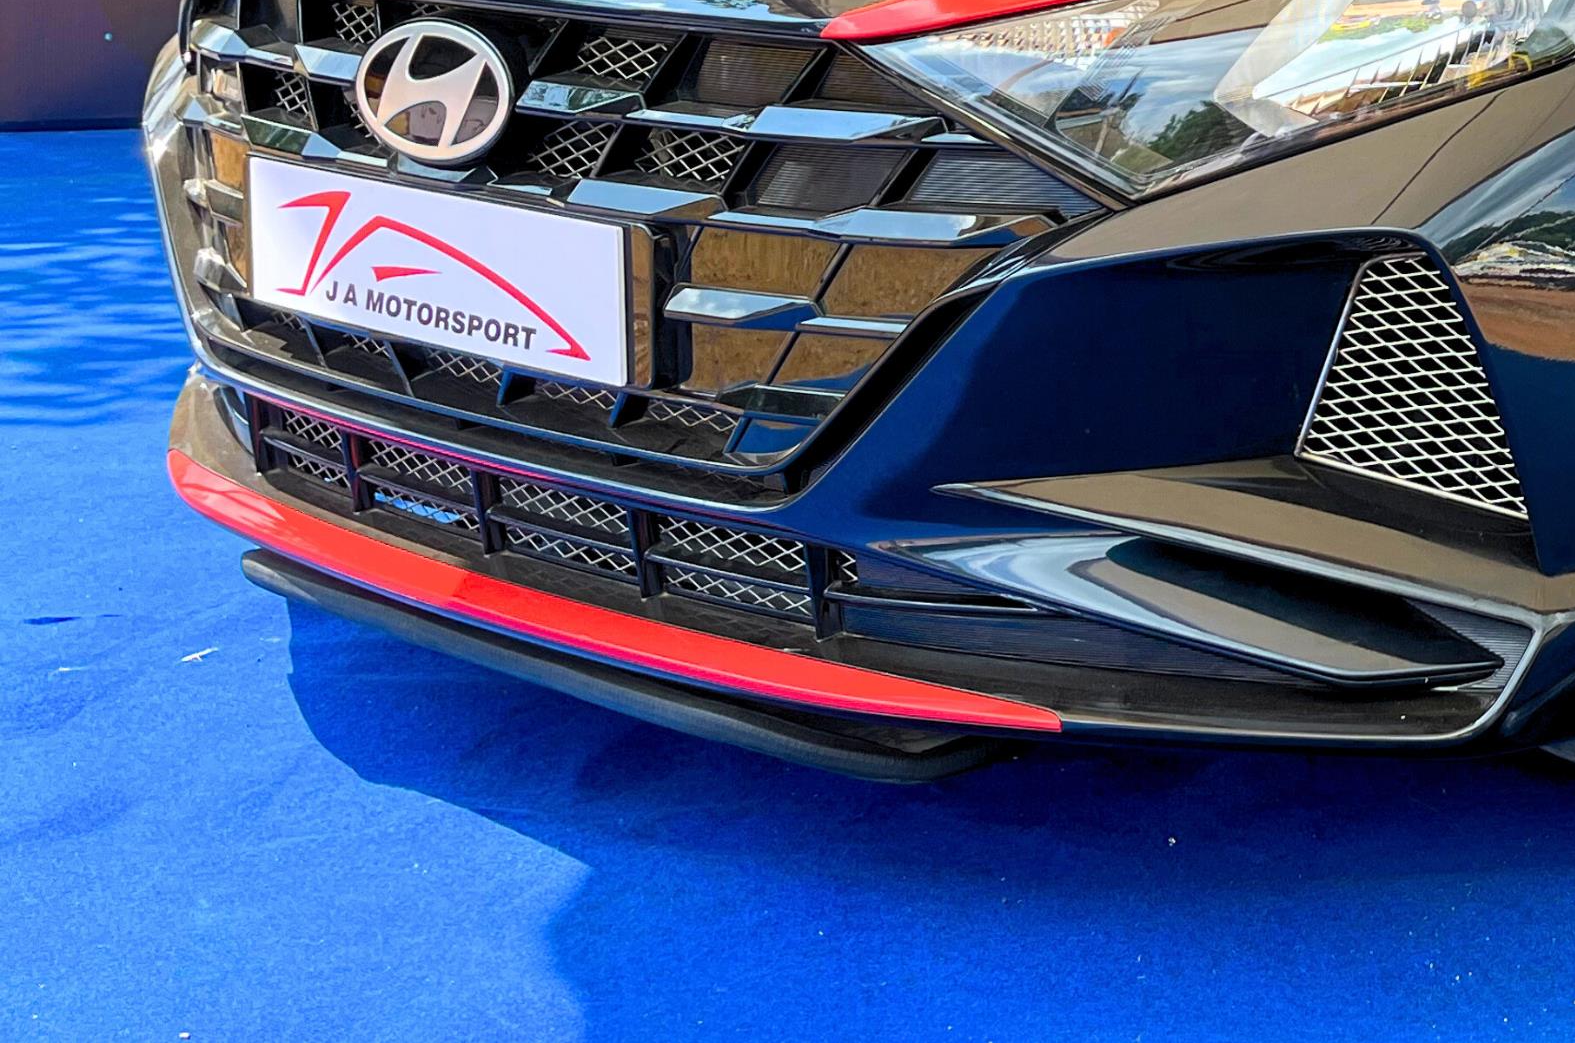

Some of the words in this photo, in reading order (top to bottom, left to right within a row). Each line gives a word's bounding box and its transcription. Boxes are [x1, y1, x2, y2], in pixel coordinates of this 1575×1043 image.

[325, 281, 339, 302] J
[343, 284, 358, 307] A
[366, 289, 537, 350] MOTORSPORT
